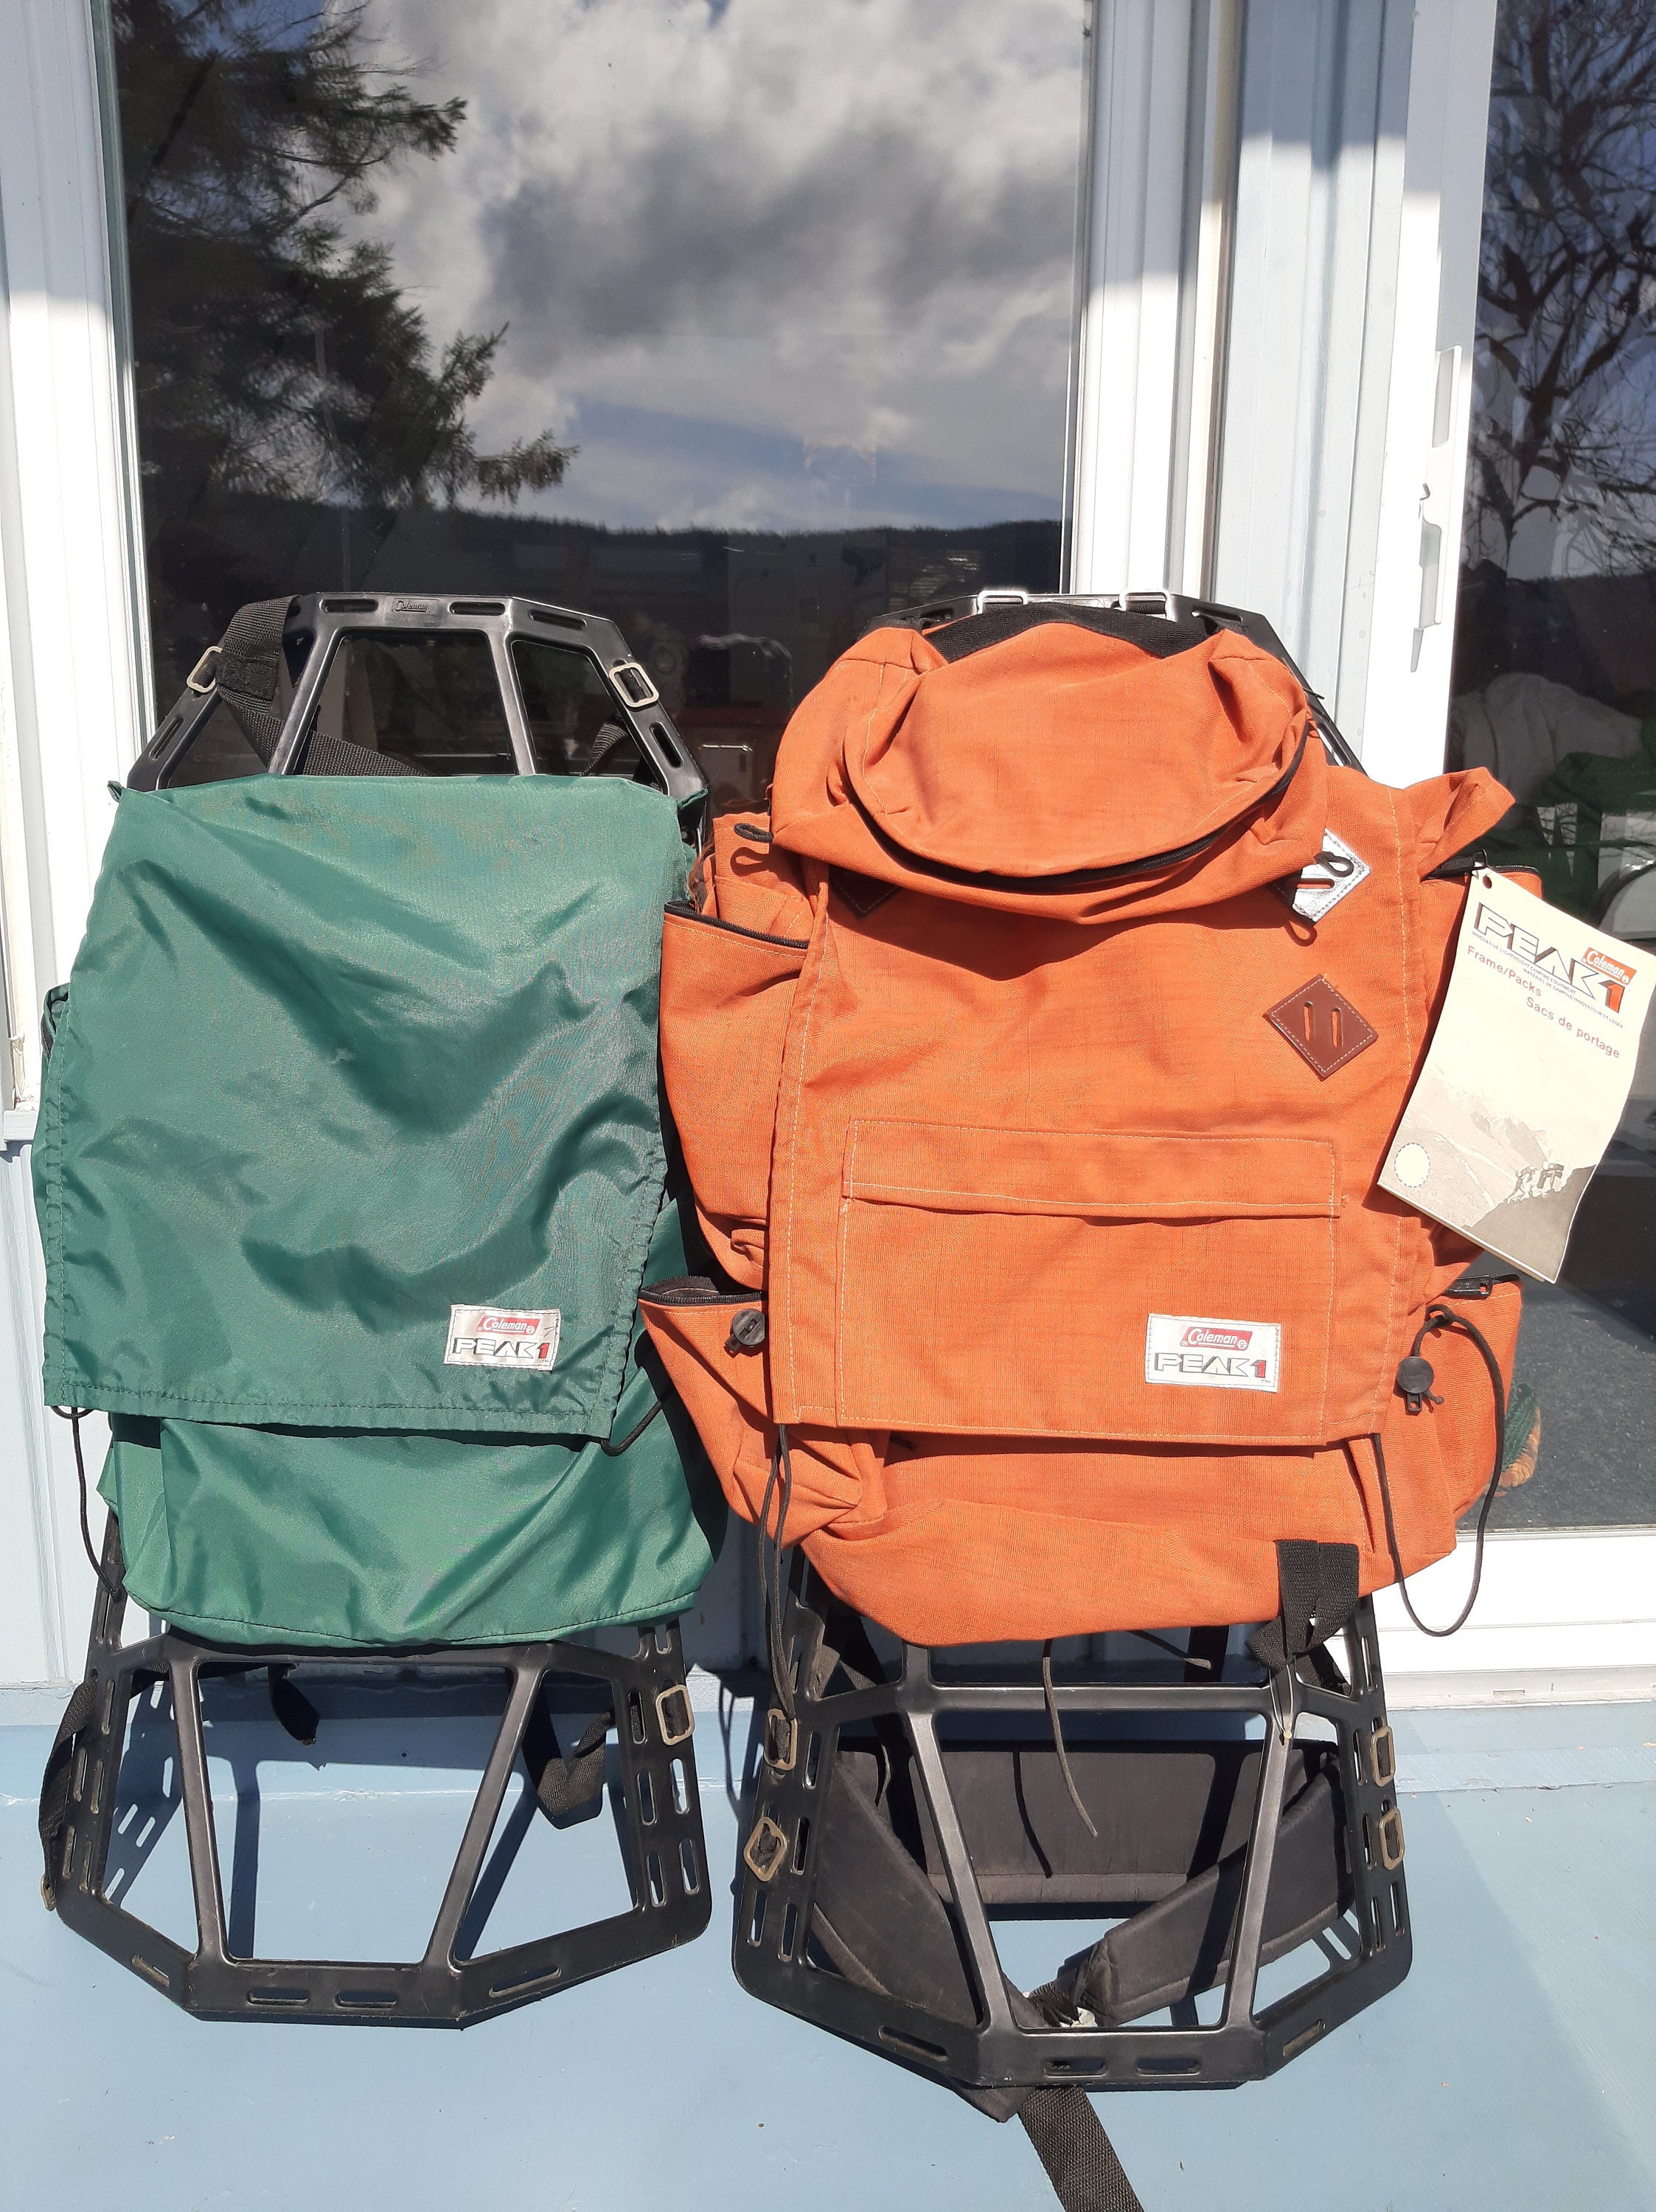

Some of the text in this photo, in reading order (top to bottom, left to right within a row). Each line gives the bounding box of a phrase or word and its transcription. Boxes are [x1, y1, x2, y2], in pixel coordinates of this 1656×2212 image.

[394, 599, 429, 613] Coleman
[1467, 945, 1542, 997] Frame/Packs
[1474, 902, 1625, 1014] PEAK 1
[1586, 950, 1625, 977] Coleman
[1526, 996, 1620, 1058] Sacs de portage
[483, 1317, 527, 1333] Coleman
[1187, 1327, 1238, 1346] Coleman
[452, 1338, 551, 1359] PEAK 1
[1154, 1352, 1267, 1378] PEAK 1
